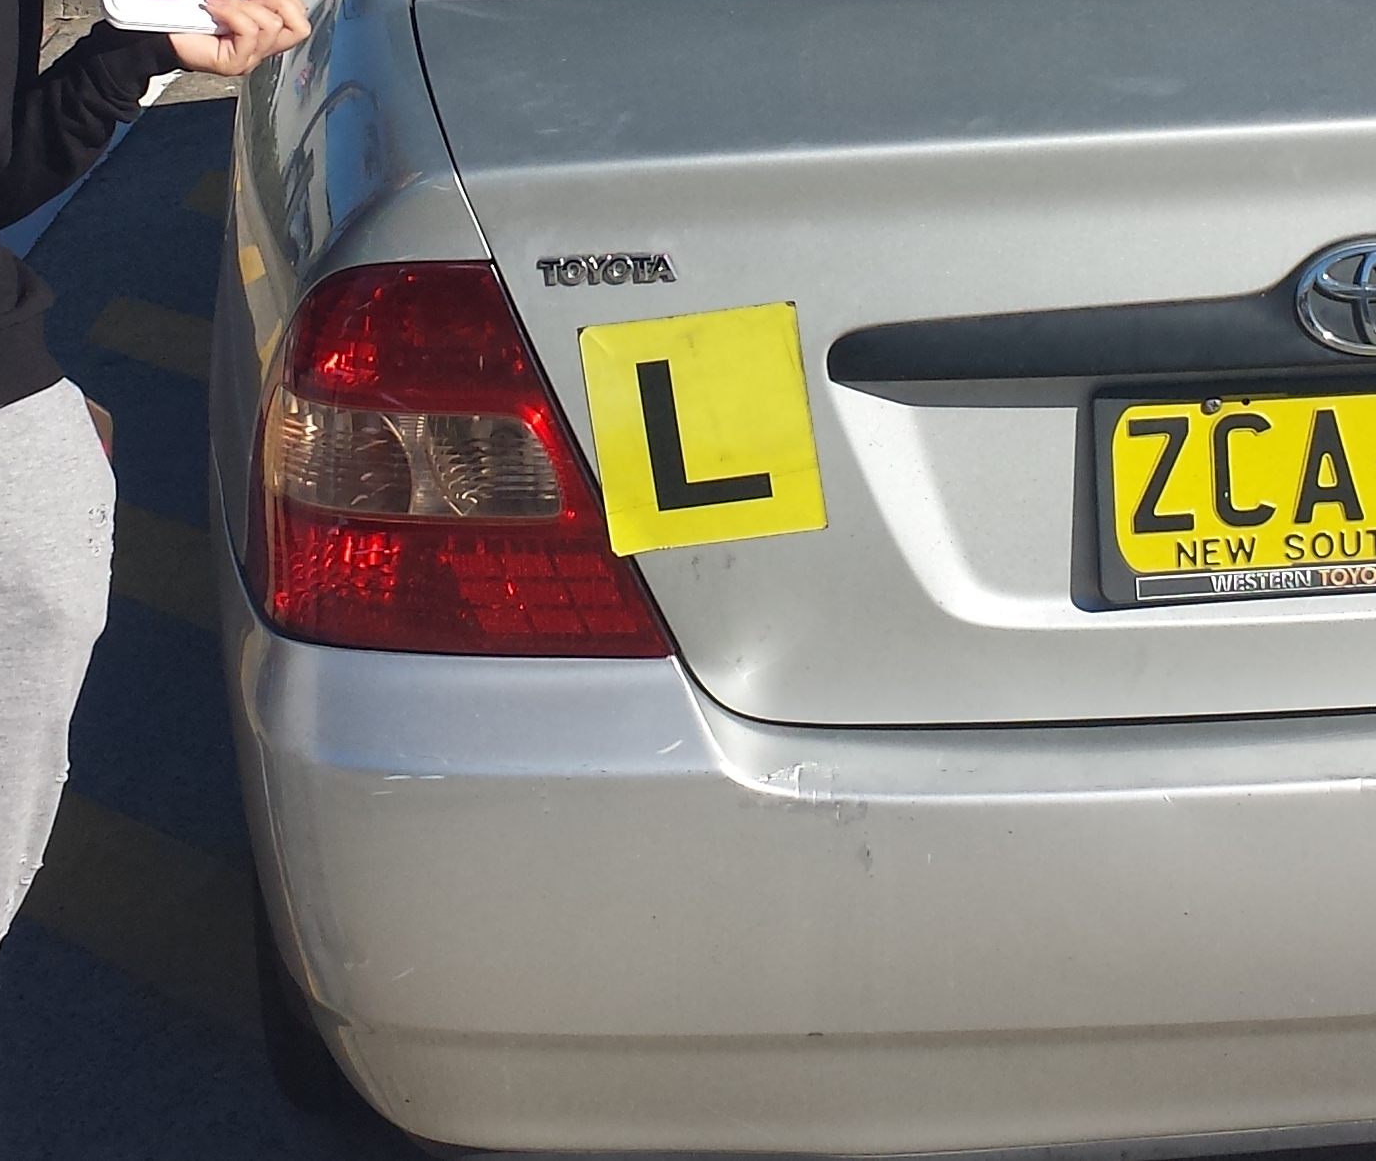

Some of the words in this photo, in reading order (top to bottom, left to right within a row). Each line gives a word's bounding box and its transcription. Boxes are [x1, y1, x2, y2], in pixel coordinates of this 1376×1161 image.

[536, 253, 677, 287] TOYOTA
[635, 359, 773, 512] L
[1176, 536, 1257, 569] NEW
[1210, 570, 1312, 593] WESTERN
